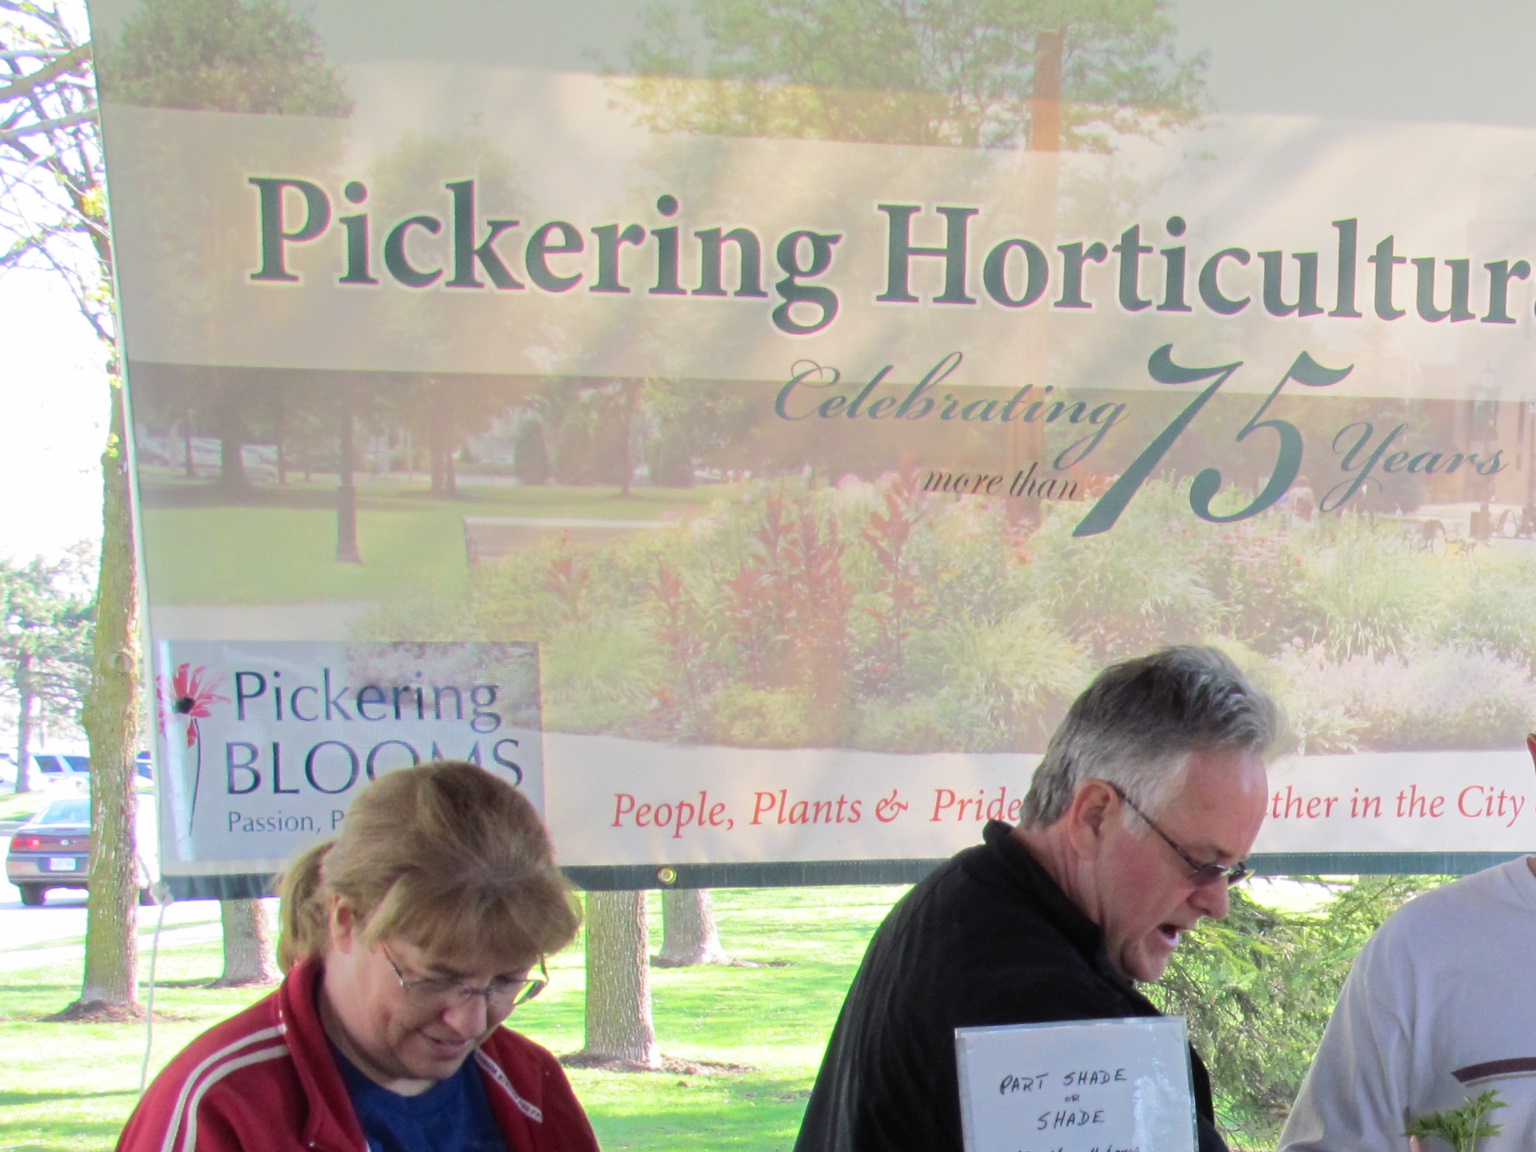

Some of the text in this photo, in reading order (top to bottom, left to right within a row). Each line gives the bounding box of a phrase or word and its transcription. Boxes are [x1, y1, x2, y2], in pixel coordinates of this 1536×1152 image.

[248, 177, 842, 335] Pickering
[774, 343, 1509, 537] Celebrating 75 Years
[923, 461, 1081, 502] more than
[234, 668, 503, 734] Pickering
[228, 811, 322, 834] Passion,
[611, 786, 1022, 839] People, Plants & Pride
[1350, 787, 1382, 819] in
[1395, 785, 1446, 819] the
[1456, 785, 1526, 829] City
[1000, 1068, 1127, 1095] PART SHADE
[1064, 1093, 1080, 1102] OR
[1037, 1109, 1105, 1130] SHADE
